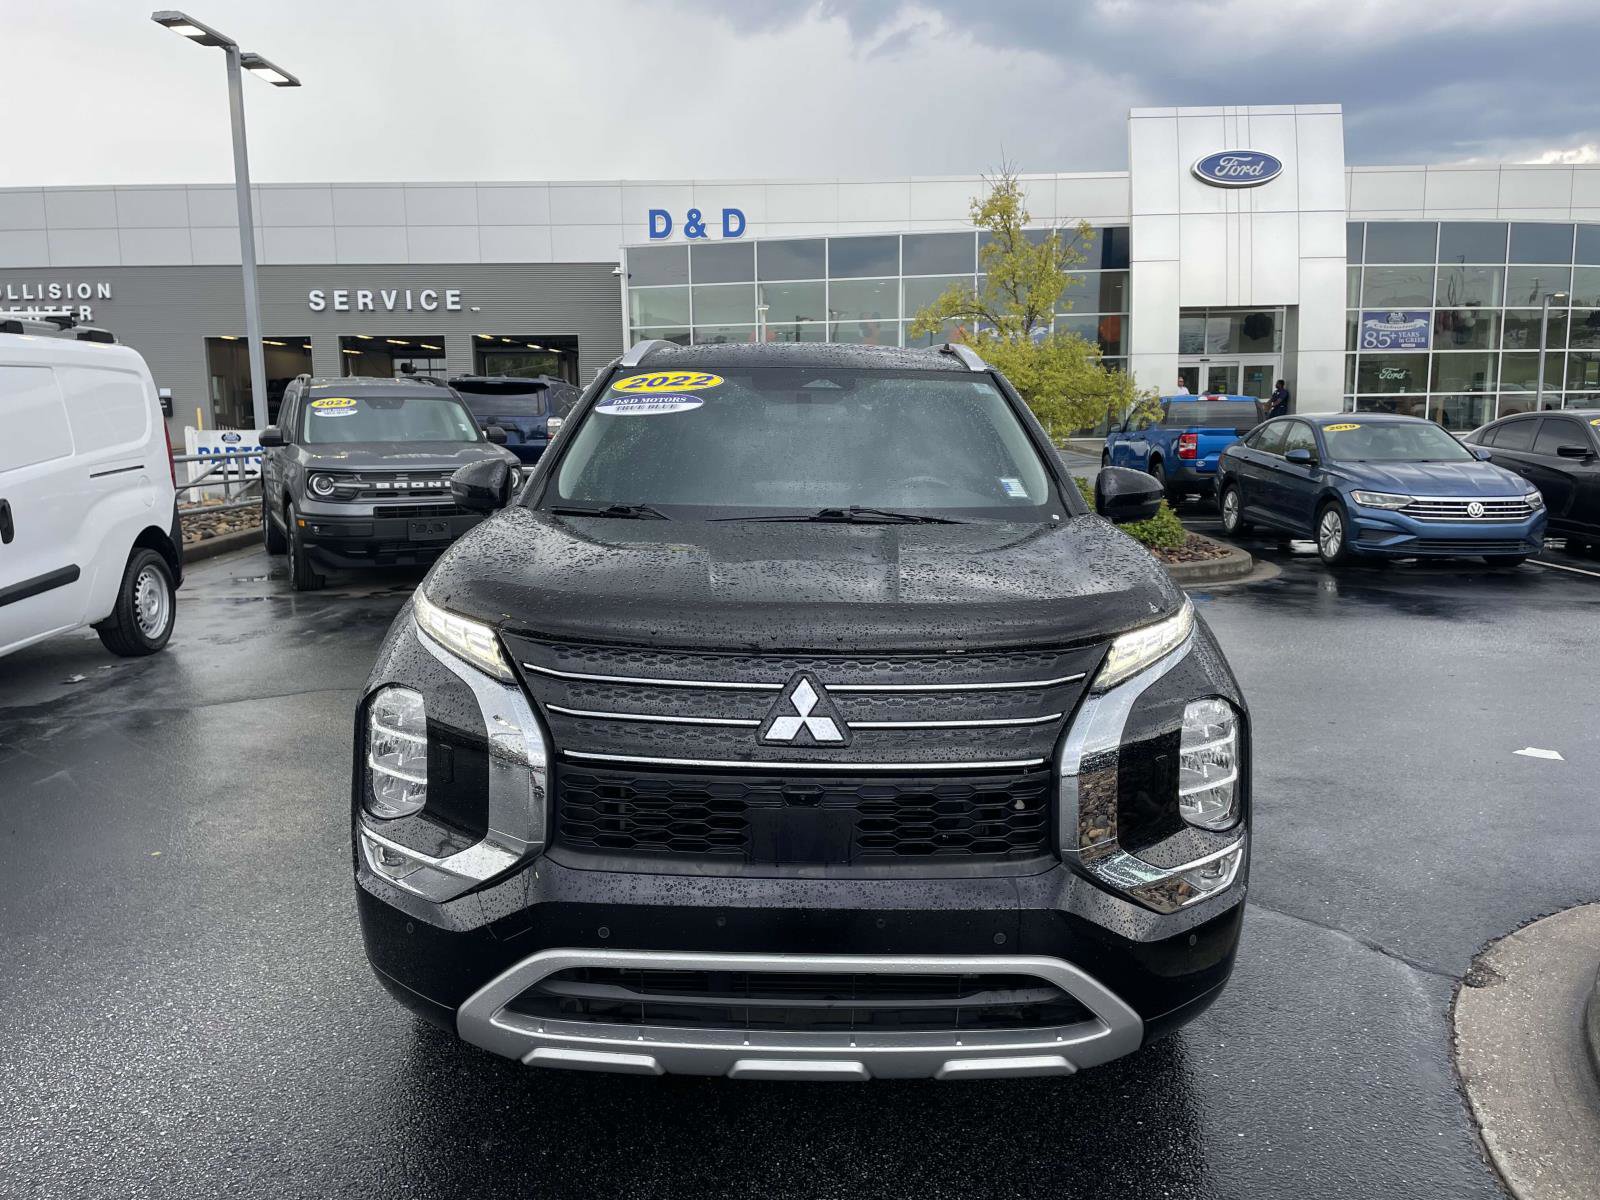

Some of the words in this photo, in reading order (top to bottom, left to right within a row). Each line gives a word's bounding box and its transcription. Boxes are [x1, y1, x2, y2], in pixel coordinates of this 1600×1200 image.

[1215, 156, 1264, 176] Ford
[648, 209, 673, 239] D
[684, 208, 708, 239] &
[722, 208, 746, 238] D
[0, 282, 111, 300] LLISION
[308, 289, 461, 311] SERVICE
[624, 375, 714, 389] 2022
[1379, 367, 1406, 379] Ford
[640, 396, 688, 404] MOTORS
[197, 446, 264, 465] PARTS
